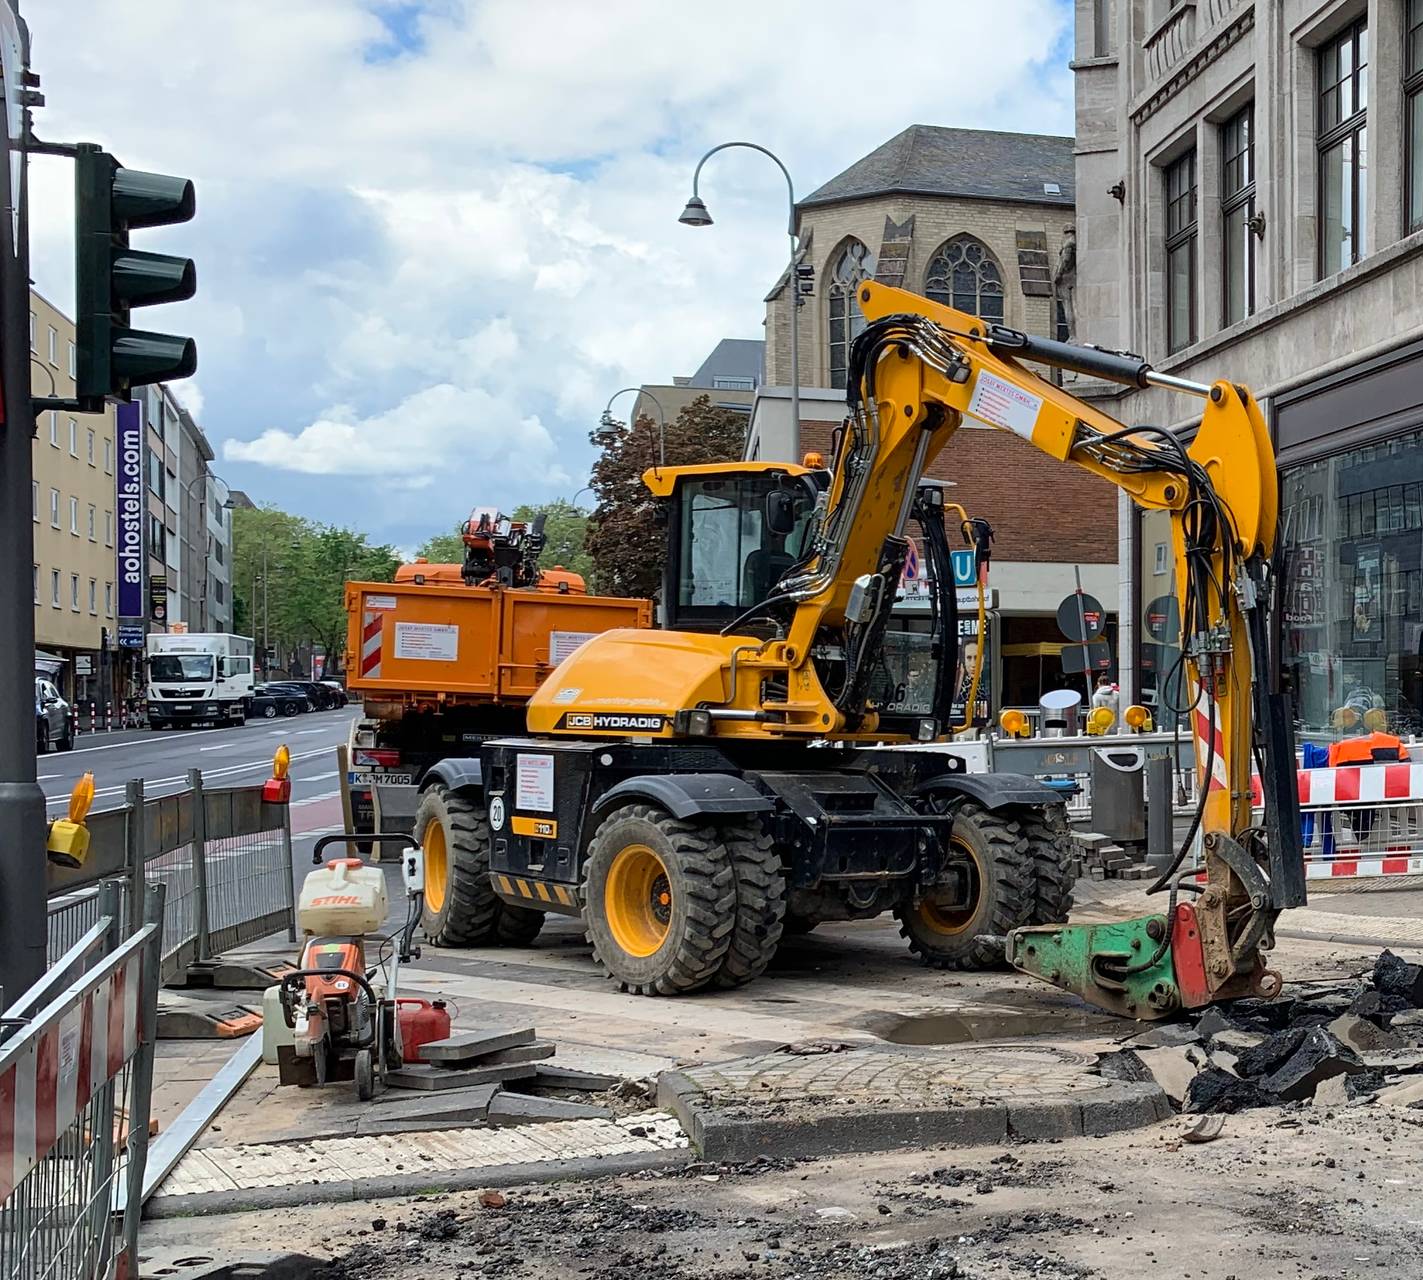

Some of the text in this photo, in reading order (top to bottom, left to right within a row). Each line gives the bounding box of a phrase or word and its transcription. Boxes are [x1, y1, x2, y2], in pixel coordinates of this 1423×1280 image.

[119, 430, 140, 584] aohostels.com
[956, 556, 971, 580] U
[569, 716, 661, 729] JCB HYDRADIG
[355, 774, 362, 784] K
[384, 774, 410, 785] 7005
[493, 805, 502, 822] 20
[310, 895, 362, 907] STIHL
